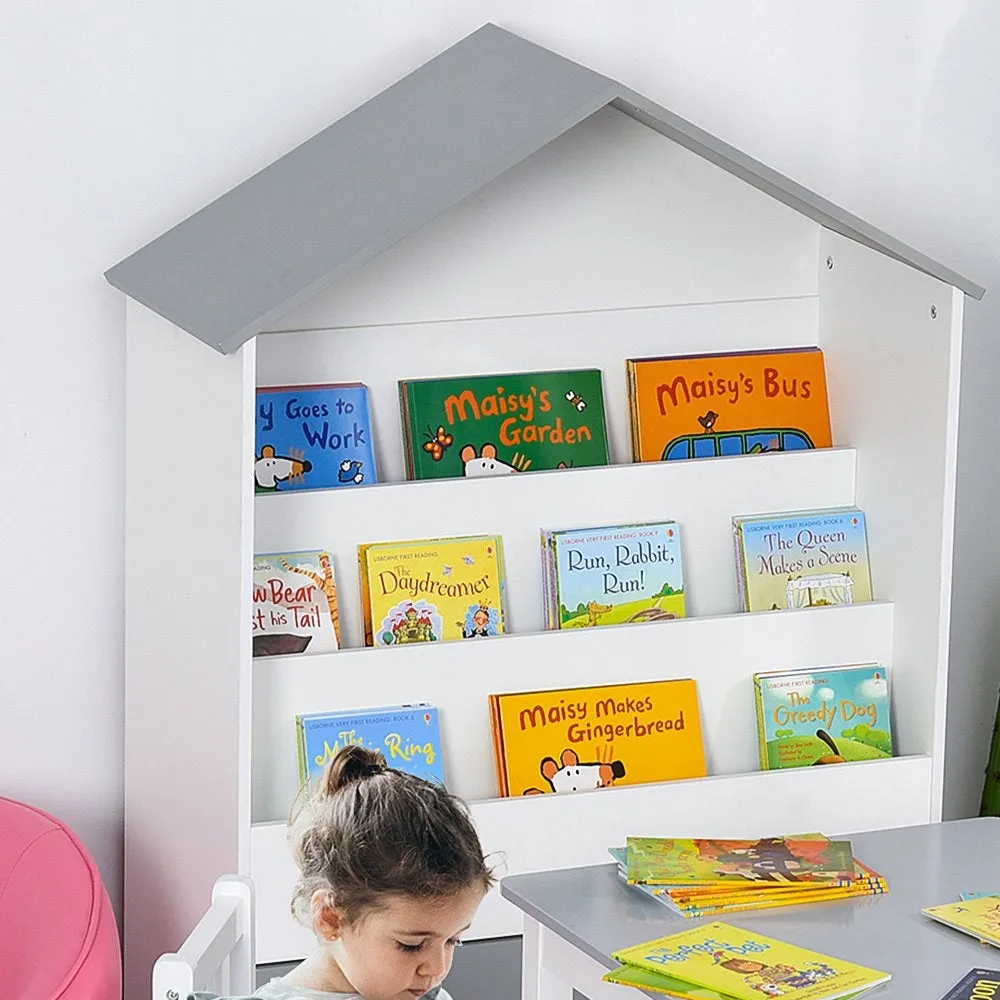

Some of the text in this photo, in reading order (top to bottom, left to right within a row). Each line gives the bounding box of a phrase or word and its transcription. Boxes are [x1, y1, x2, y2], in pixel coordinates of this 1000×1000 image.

[444, 385, 553, 426] Maisy's
[657, 367, 811, 416] Maisy's Bus
[286, 398, 329, 419] Goes
[336, 398, 354, 415] to
[302, 421, 366, 450] Work
[499, 417, 592, 446] Garden
[764, 529, 846, 553] The Queen
[394, 565, 411, 576] The
[567, 541, 674, 571] Run, Rabbit,
[757, 545, 858, 576] Makes a Scene
[267, 579, 316, 605] Bear
[379, 570, 491, 597] Daydreamer
[603, 570, 645, 594] Run!
[270, 610, 287, 626] his
[287, 605, 321, 629] Tail
[787, 691, 811, 706] The
[519, 696, 653, 731] Maisy Makes
[567, 710, 685, 743] Gingerbread
[773, 700, 877, 730] Greedy Dog
[338, 729, 363, 746] The
[384, 733, 436, 765] Ring
